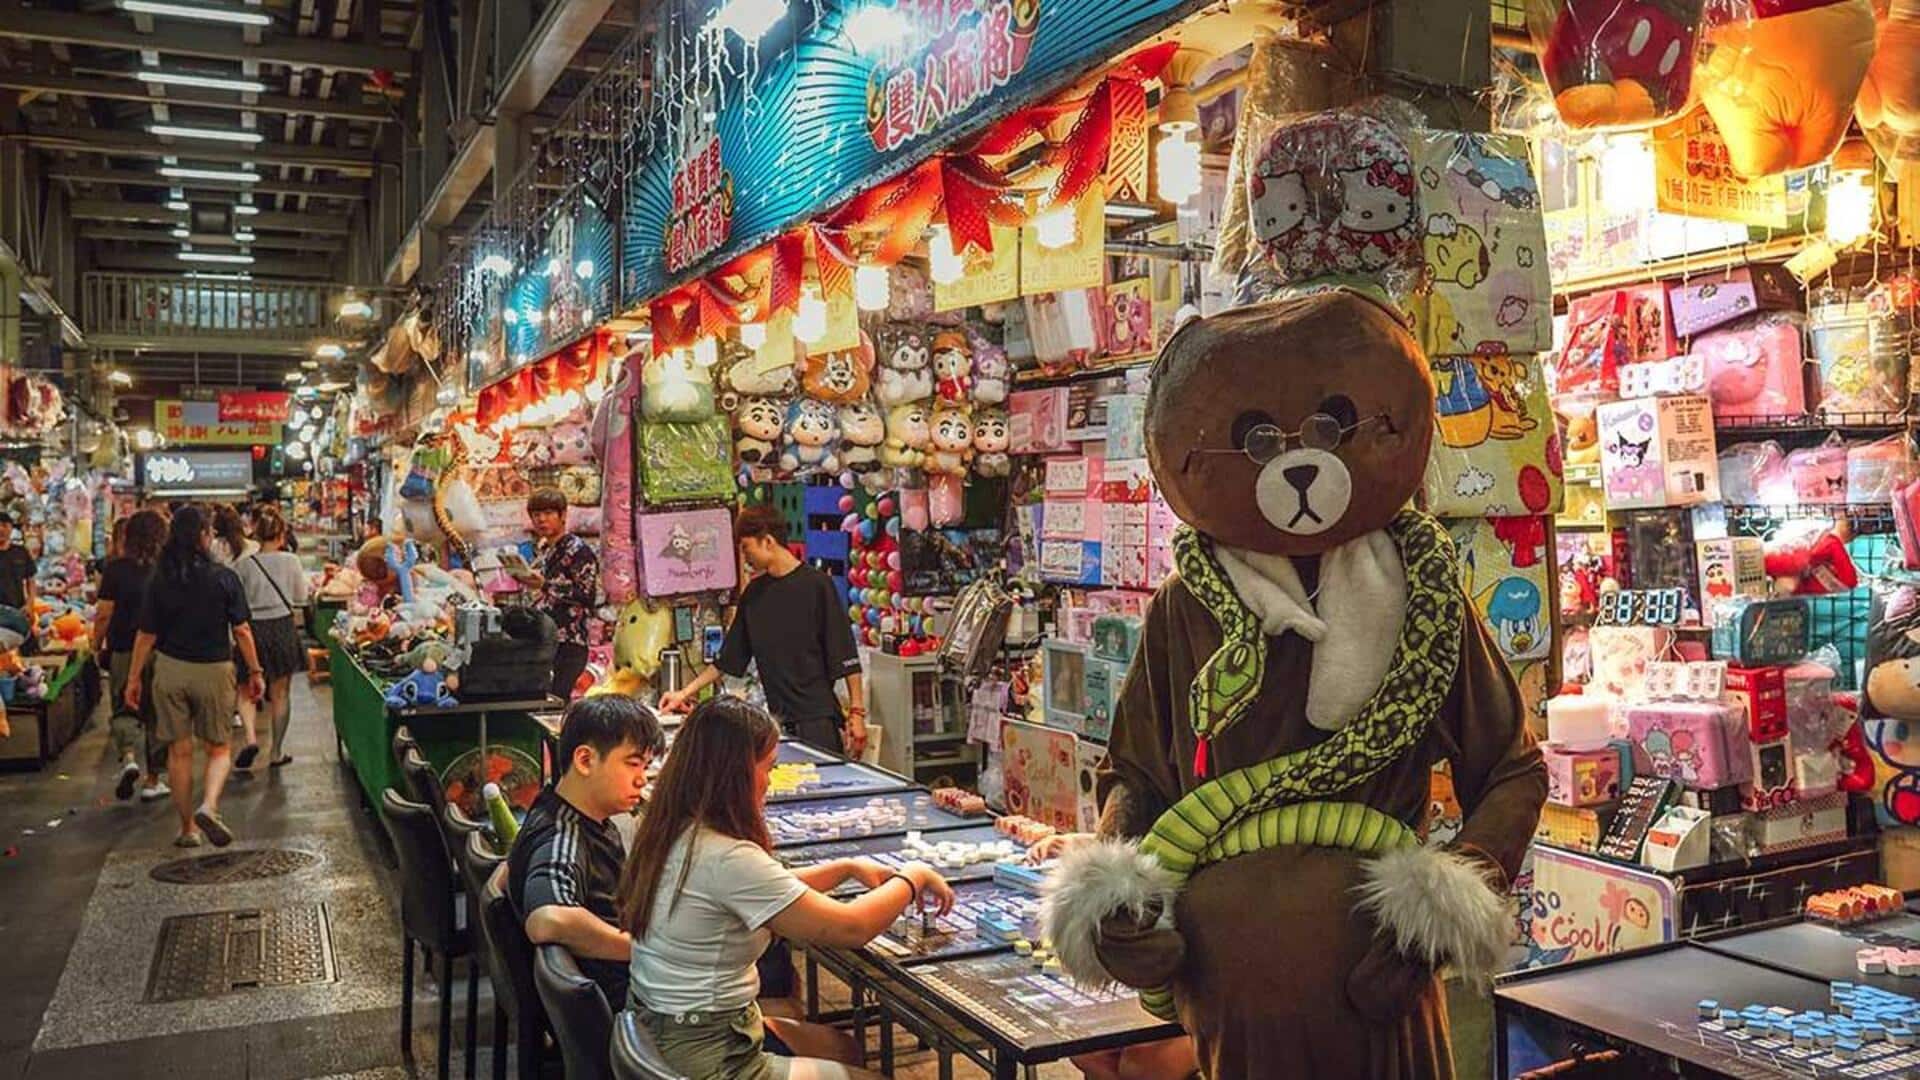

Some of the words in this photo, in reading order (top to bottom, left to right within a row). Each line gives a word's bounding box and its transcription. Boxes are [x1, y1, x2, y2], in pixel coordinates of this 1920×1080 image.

[888, 4, 1011, 148] 雙人麻將
[671, 193, 721, 271] 雙人麻將
